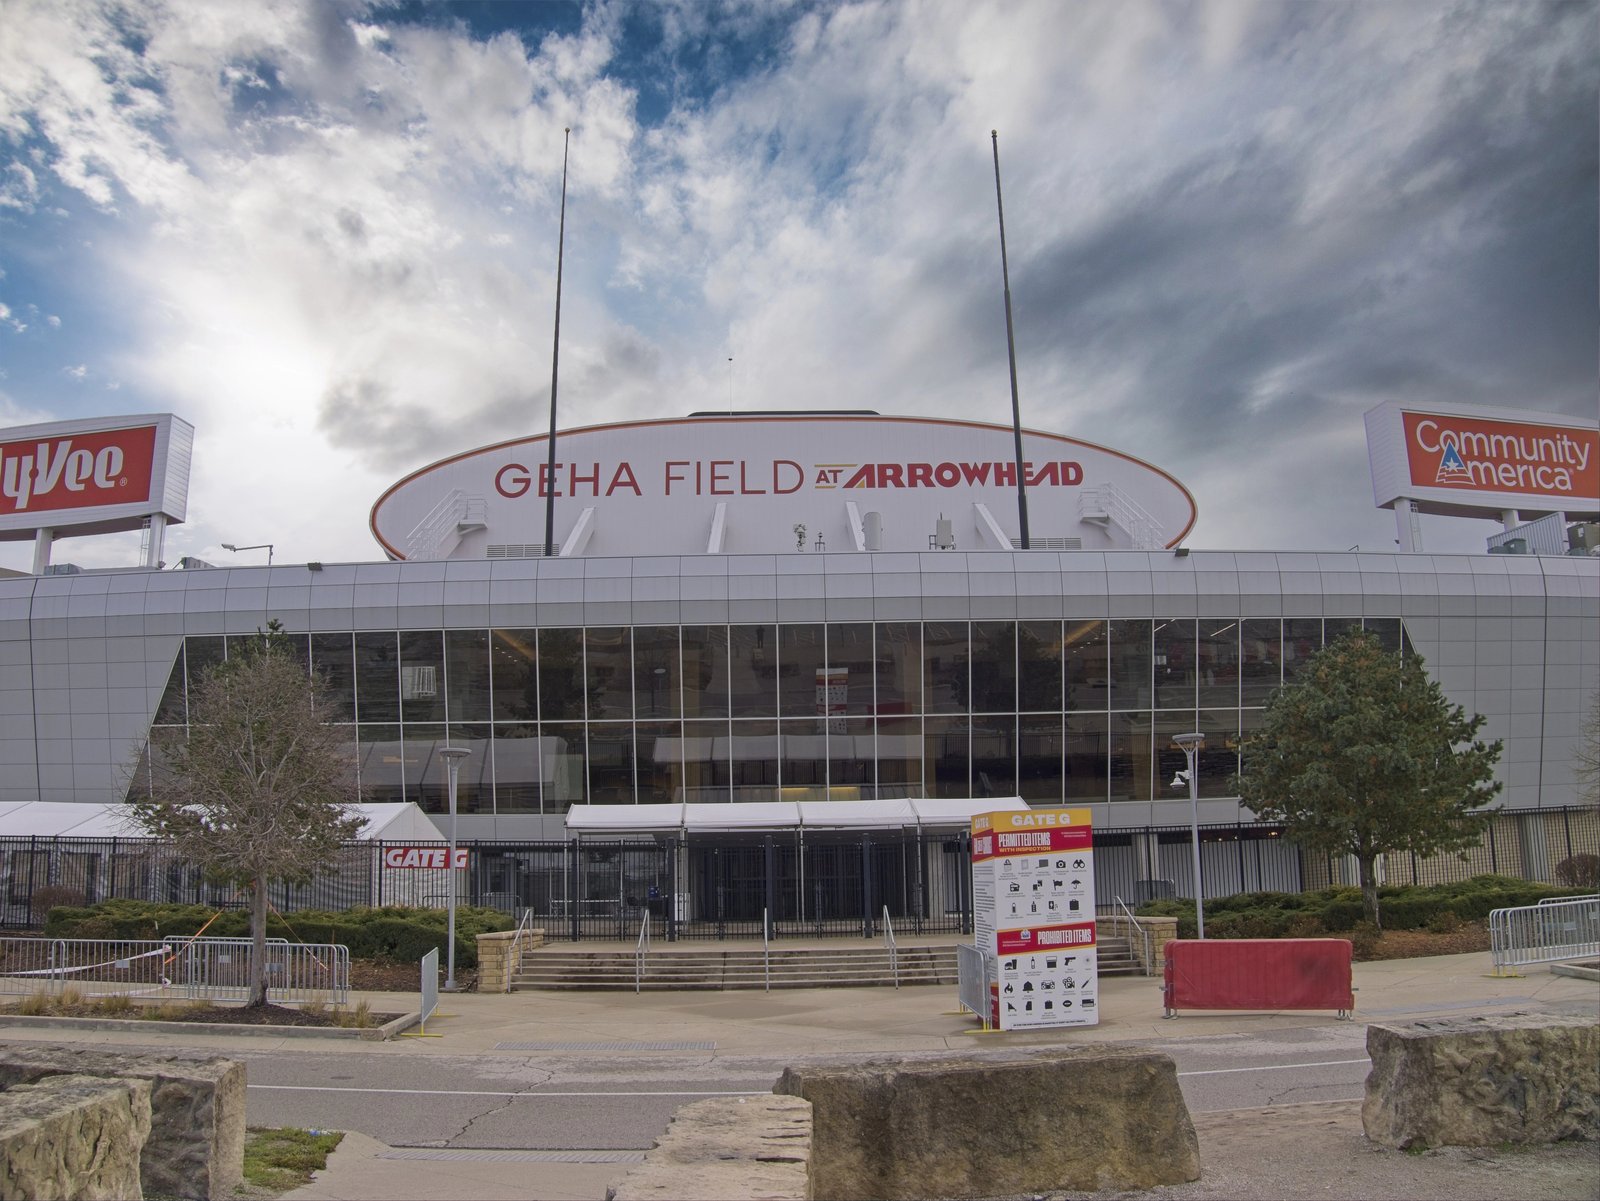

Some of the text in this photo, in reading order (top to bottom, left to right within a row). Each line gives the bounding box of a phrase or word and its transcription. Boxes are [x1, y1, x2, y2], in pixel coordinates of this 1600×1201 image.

[1416, 420, 1589, 471] Community
[494, 459, 1084, 499] GEHA FIELD AT ARROWHEAD
[1011, 813, 1071, 827] GATE G
[998, 833, 1032, 848] PERMITTED
[1032, 832, 1051, 846] ITEMS
[387, 849, 468, 868] GATE G
[1037, 930, 1073, 945] PROHIBITED
[1073, 928, 1092, 943] ITEMS
